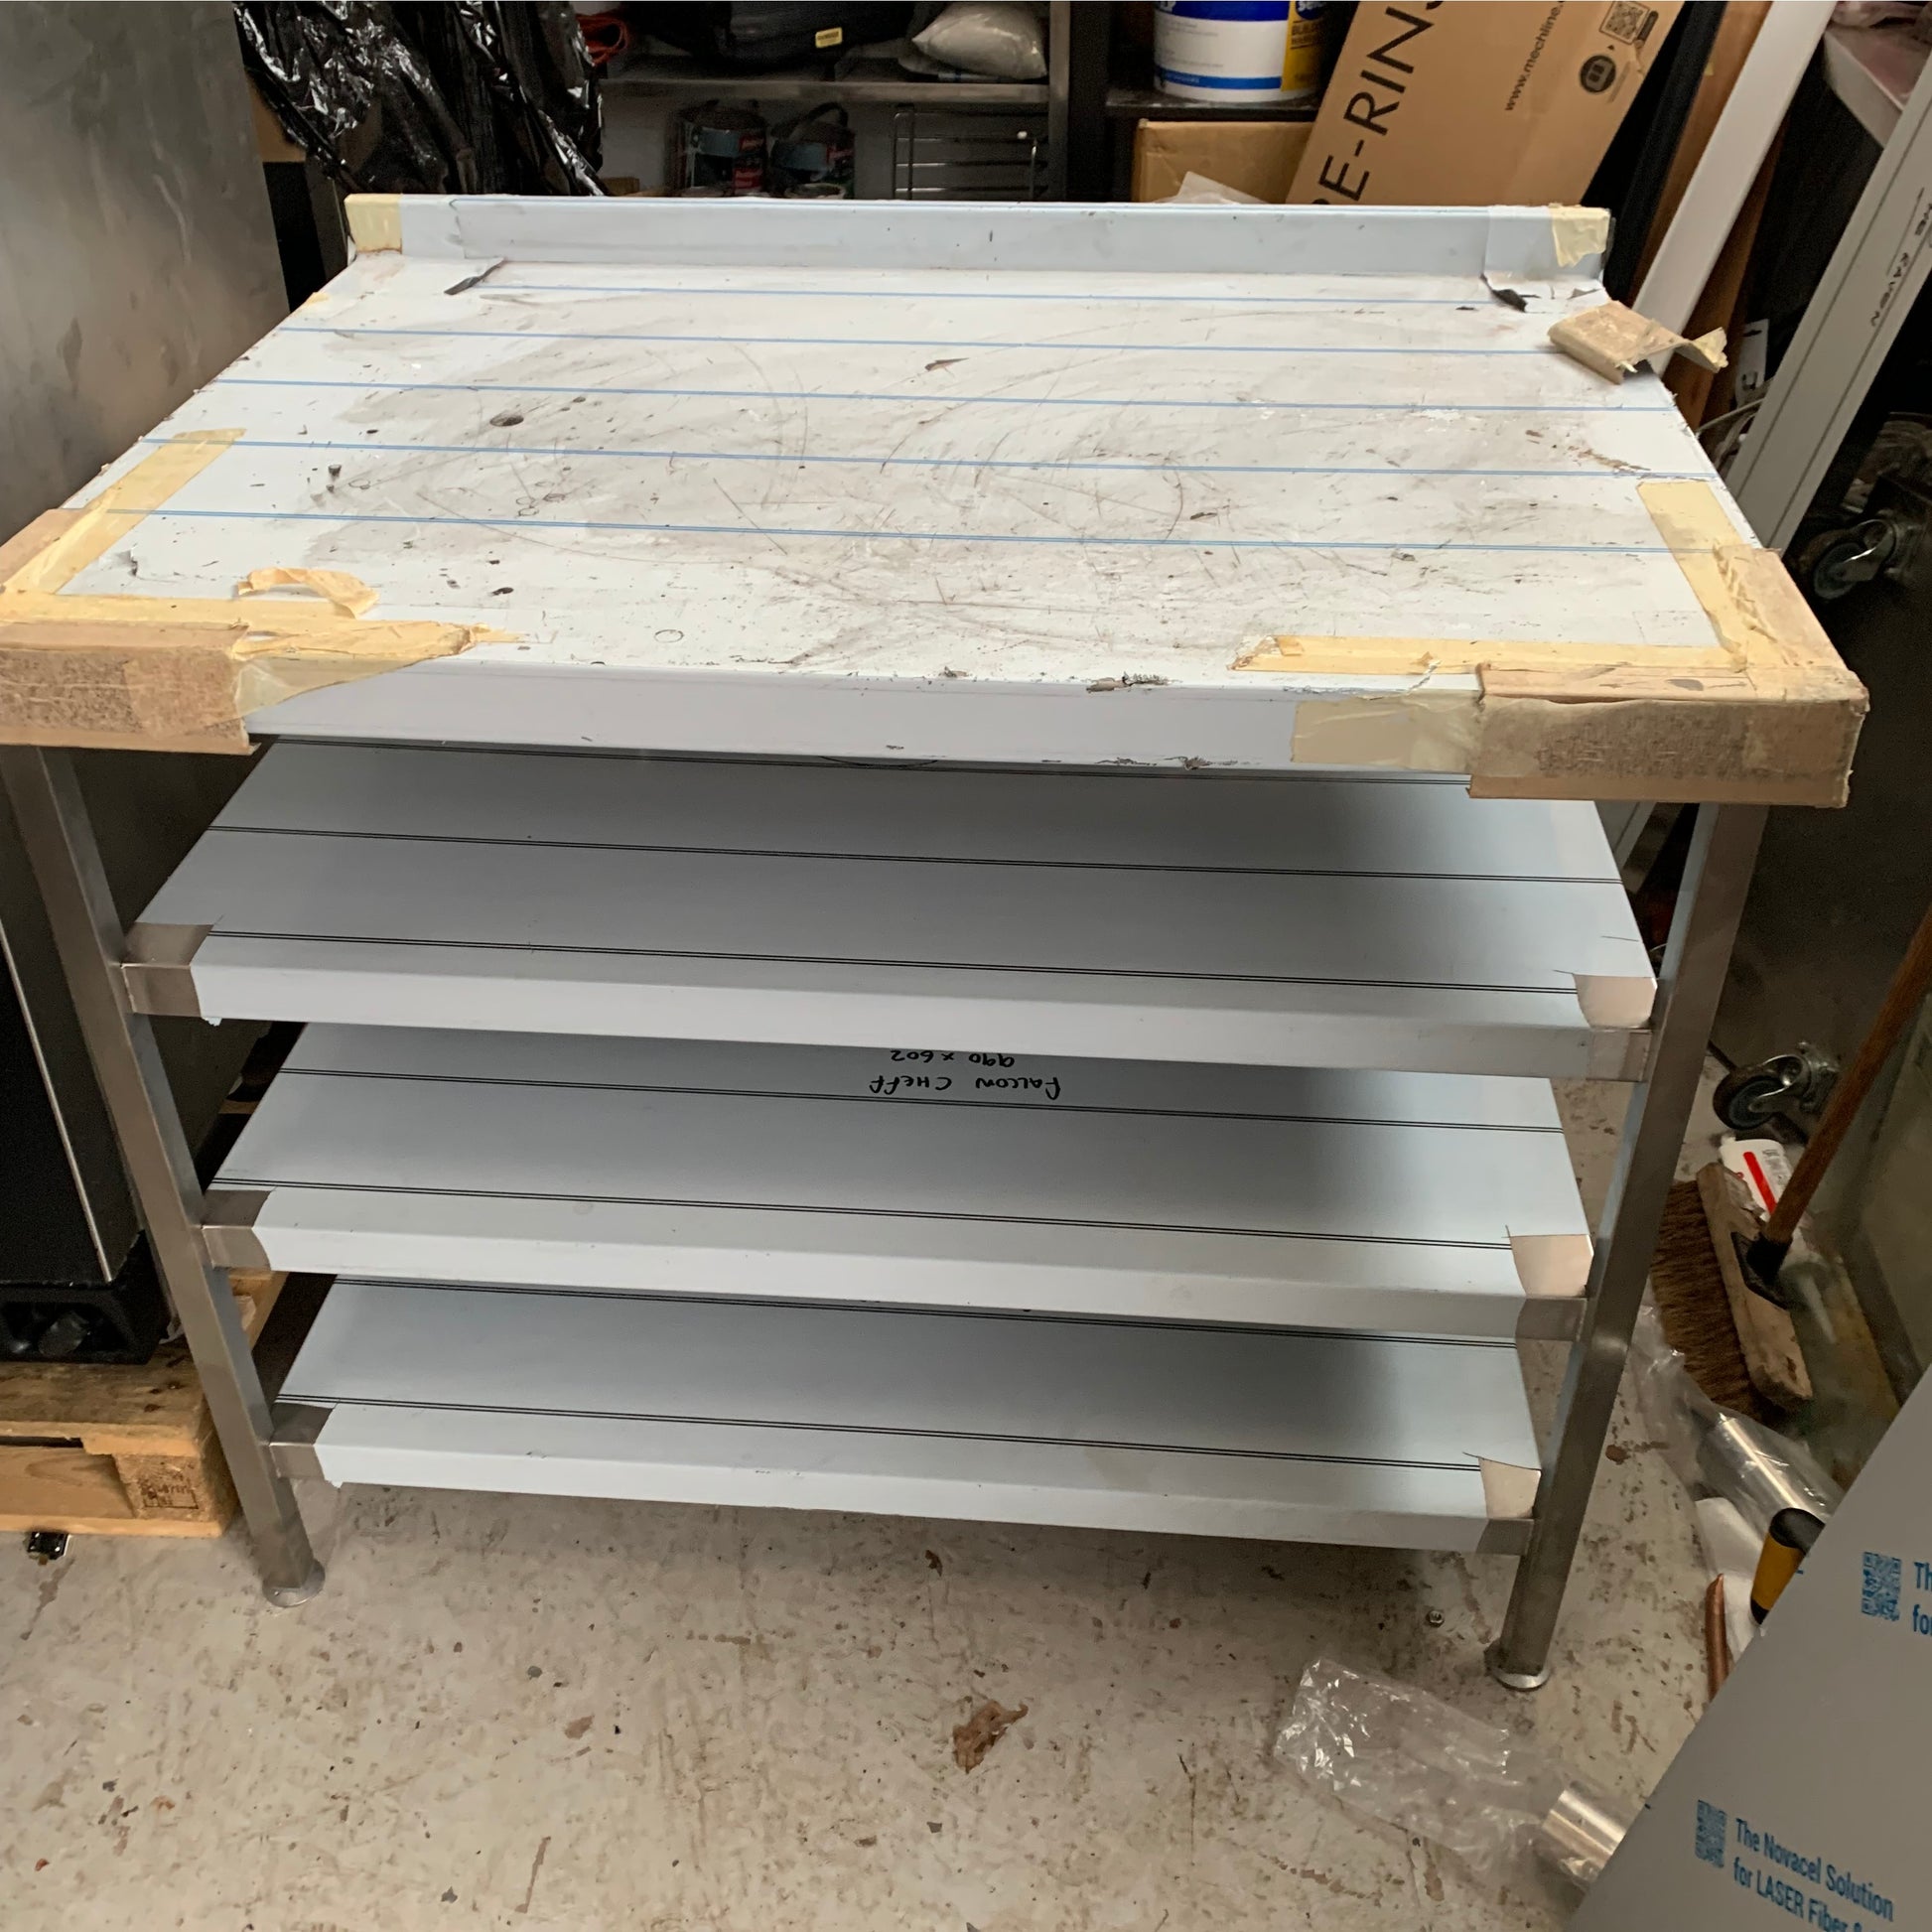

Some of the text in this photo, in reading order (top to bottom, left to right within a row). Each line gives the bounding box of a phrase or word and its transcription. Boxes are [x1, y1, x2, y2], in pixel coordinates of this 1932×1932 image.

[1504, 1, 1565, 110] www.mechline.
[1311, 1, 1444, 205] E-RIN
[890, 1049, 934, 1063] 602
[1912, 1603, 1932, 1637] fo
[1732, 1856, 1753, 1888] for
[1756, 1869, 1804, 1918] LASER
[1735, 1817, 1893, 1922] The Novacel Solution
